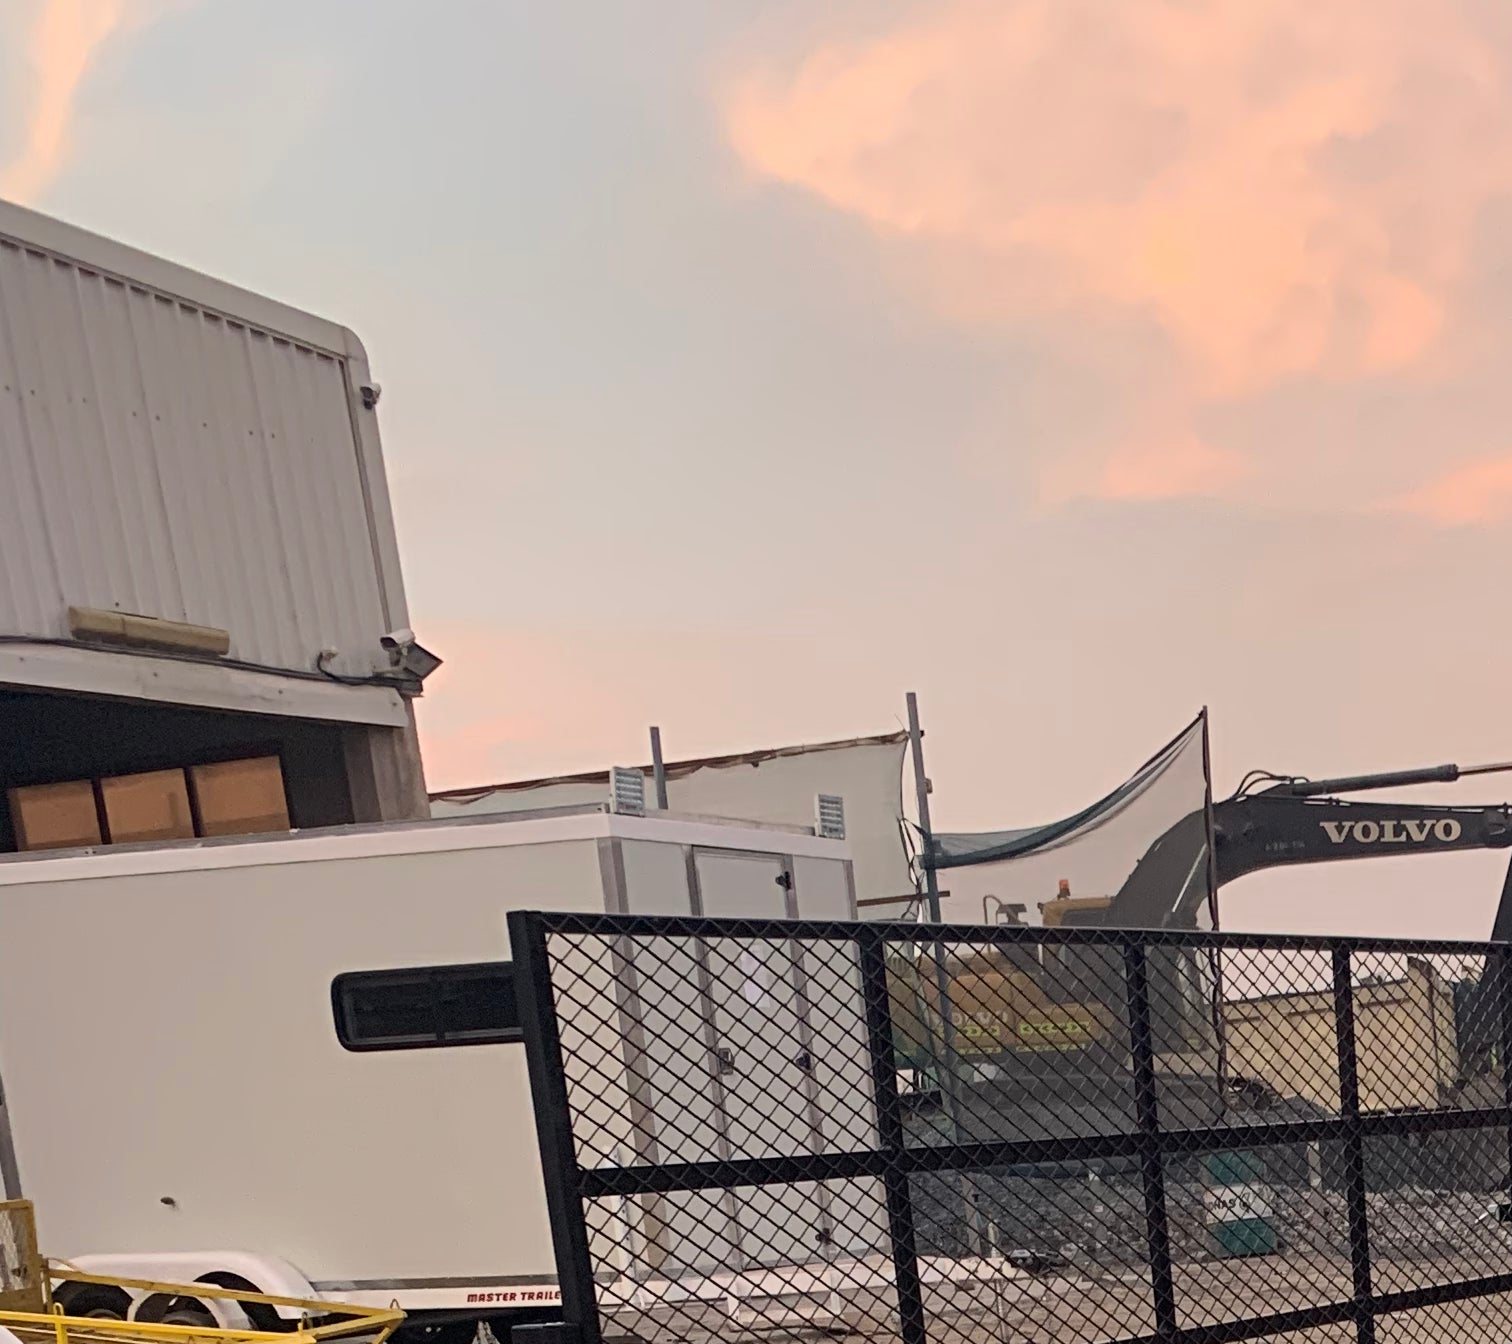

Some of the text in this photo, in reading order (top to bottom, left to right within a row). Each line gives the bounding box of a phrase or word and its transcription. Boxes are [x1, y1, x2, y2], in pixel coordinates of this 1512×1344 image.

[1319, 818, 1462, 843] VOLVO
[466, 1290, 562, 1303] MASTER TRAILE
